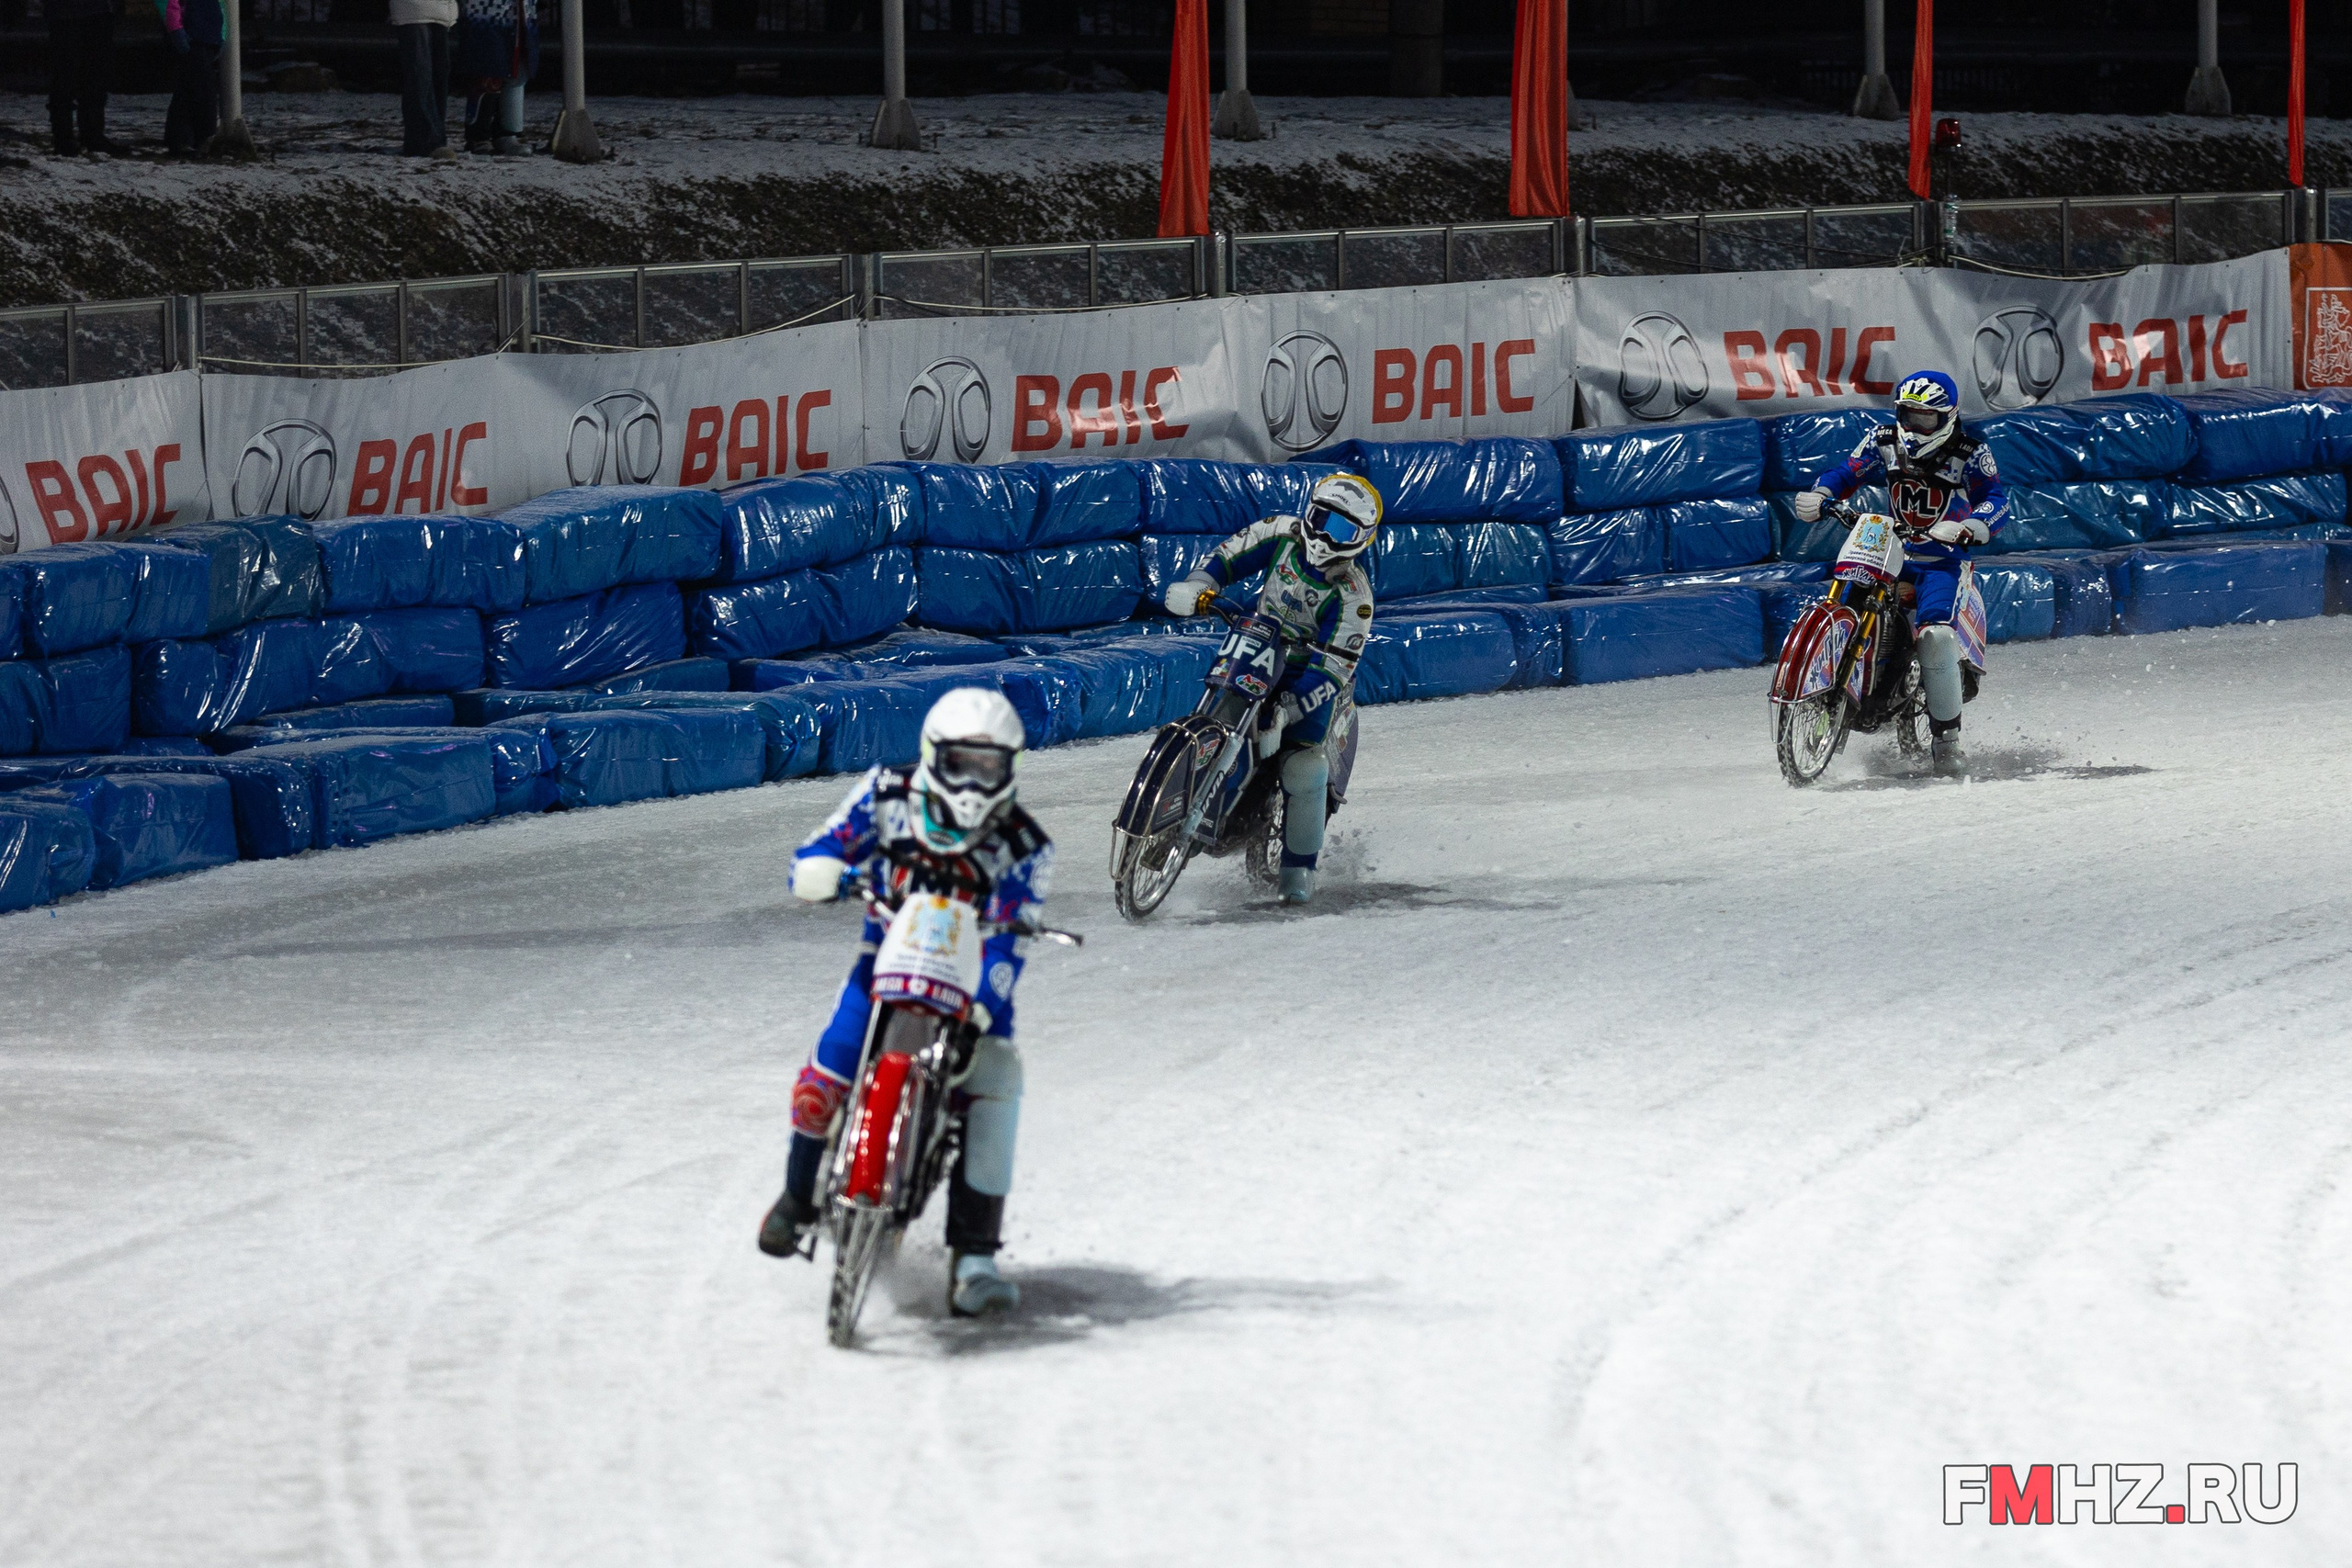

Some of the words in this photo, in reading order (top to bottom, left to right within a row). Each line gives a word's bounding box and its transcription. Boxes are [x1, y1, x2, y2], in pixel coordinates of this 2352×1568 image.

[1372, 339, 1534, 423] BAIC
[1724, 326, 1895, 401] BAIC
[2088, 310, 2248, 390] BAIC
[679, 389, 831, 487] BAIC
[1012, 367, 1189, 452] BAIC
[26, 444, 180, 545] BAIC
[347, 422, 487, 515] BAIC
[1217, 633, 1275, 677] UFA
[1301, 681, 1337, 713] UFA
